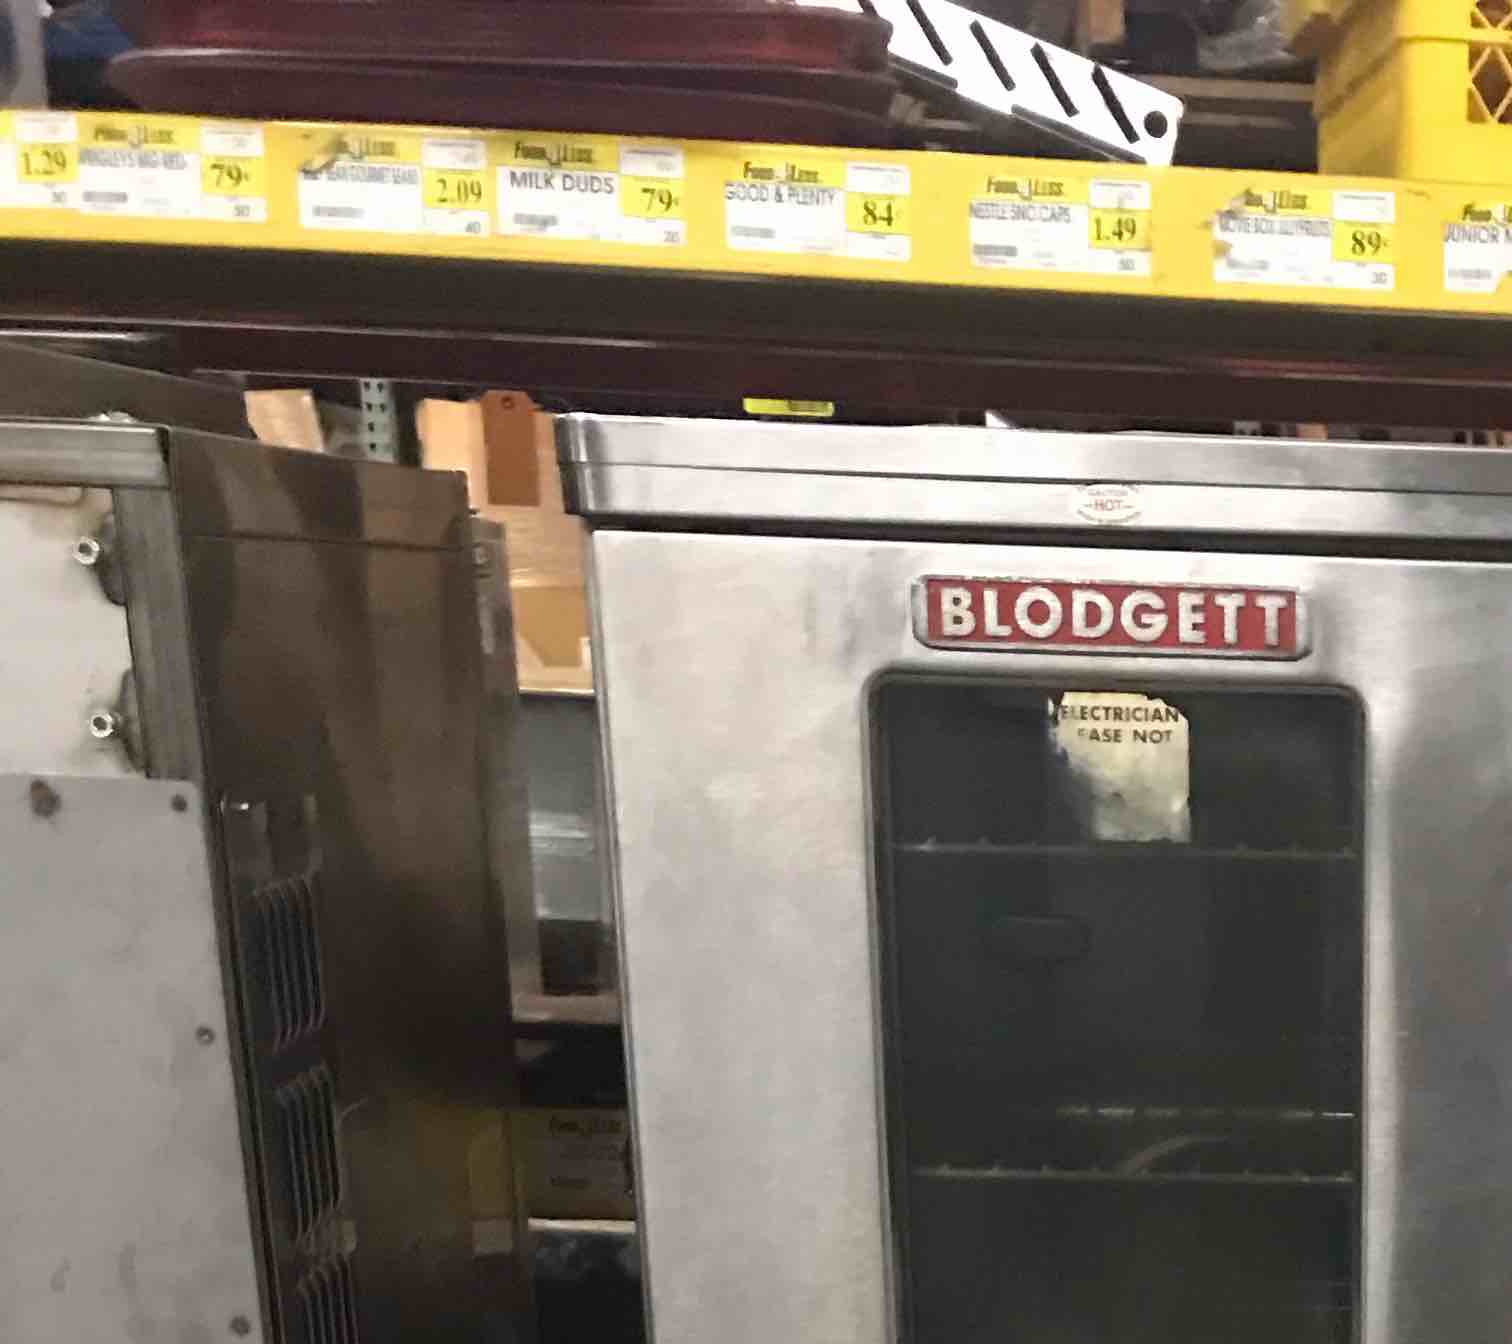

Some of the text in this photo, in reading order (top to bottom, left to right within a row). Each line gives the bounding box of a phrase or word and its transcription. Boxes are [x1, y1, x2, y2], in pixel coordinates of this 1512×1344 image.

[510, 170, 614, 195] MILK DUDS
[725, 183, 769, 203] GOOD
[787, 187, 835, 206] PLENTY
[863, 200, 894, 226] 84
[1093, 217, 1137, 241] 1.49
[1445, 225, 1500, 244] JUNIOR
[1094, 499, 1123, 511] HOT
[939, 586, 1288, 647] BLODGETT
[1060, 704, 1179, 722] ELECTRICIAN
